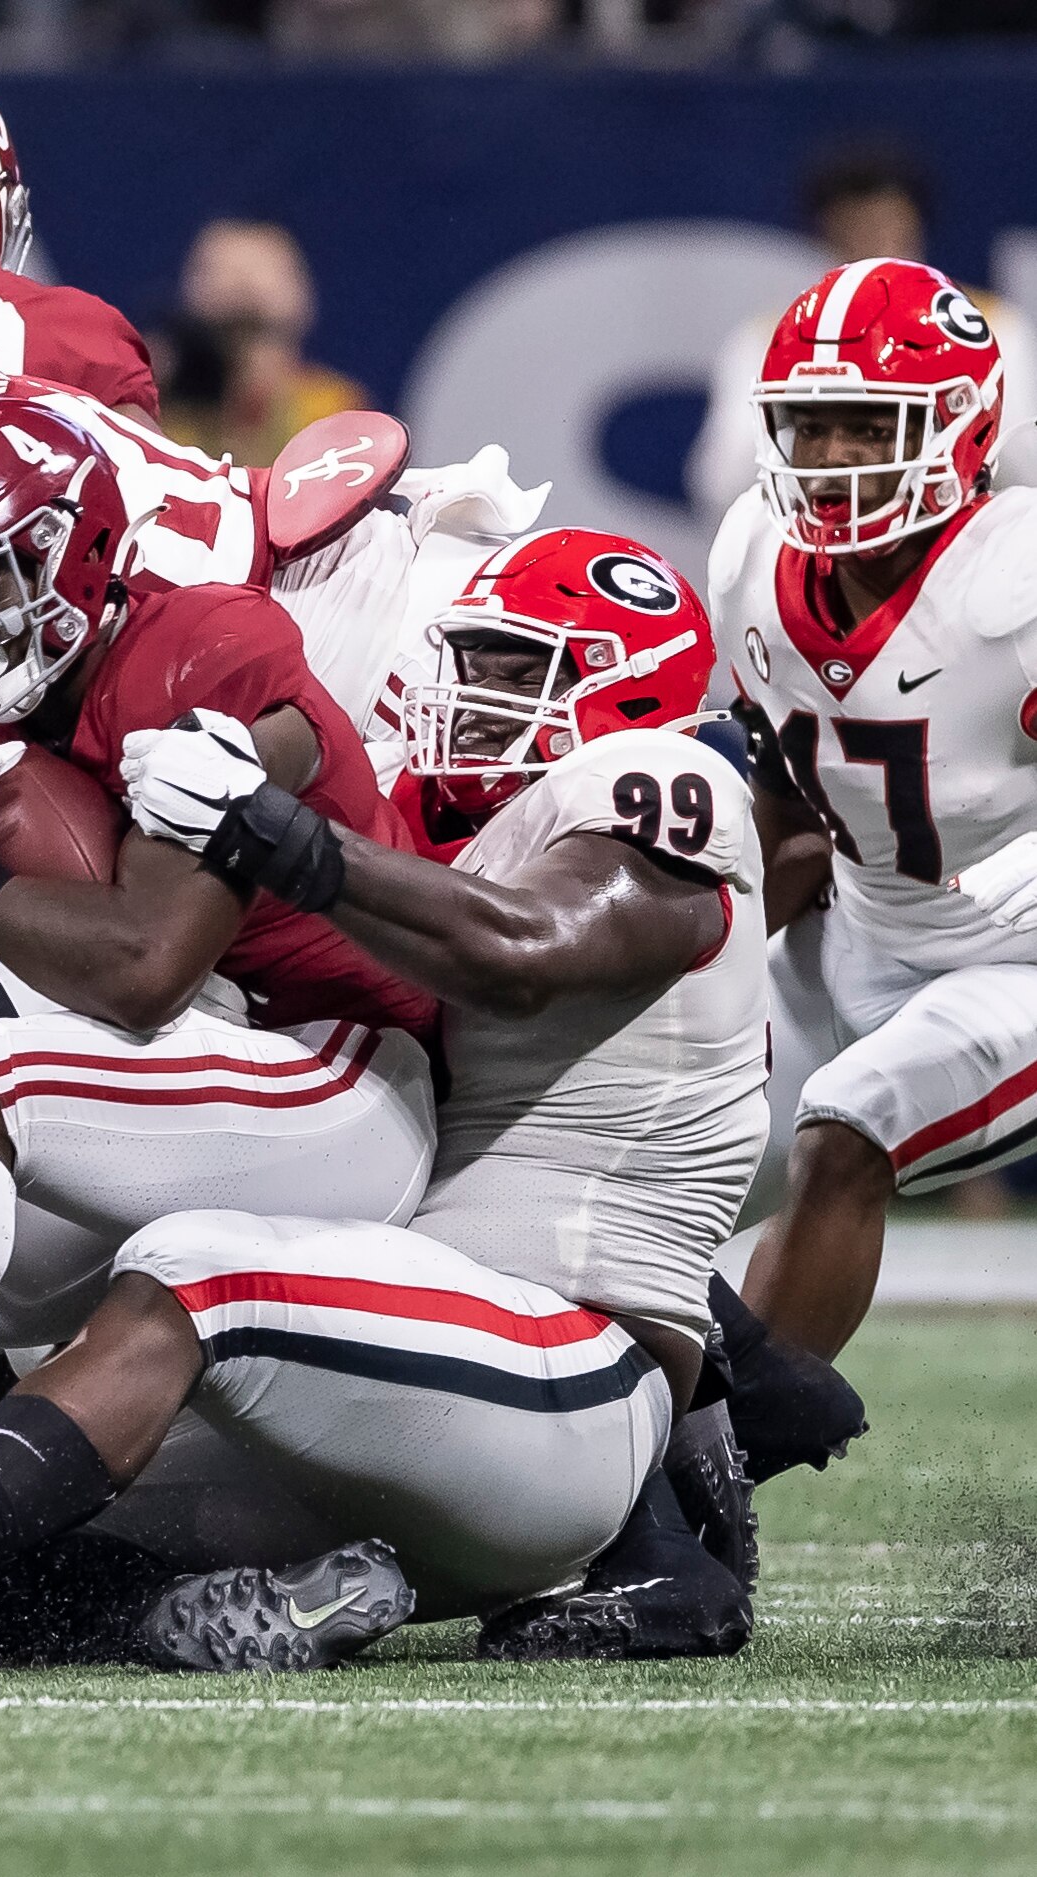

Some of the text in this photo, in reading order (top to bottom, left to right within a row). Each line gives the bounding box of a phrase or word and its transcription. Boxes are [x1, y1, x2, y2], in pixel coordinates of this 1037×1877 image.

[0, 424, 77, 474] 4
[611, 772, 713, 856] 99
[778, 708, 943, 886] 17
